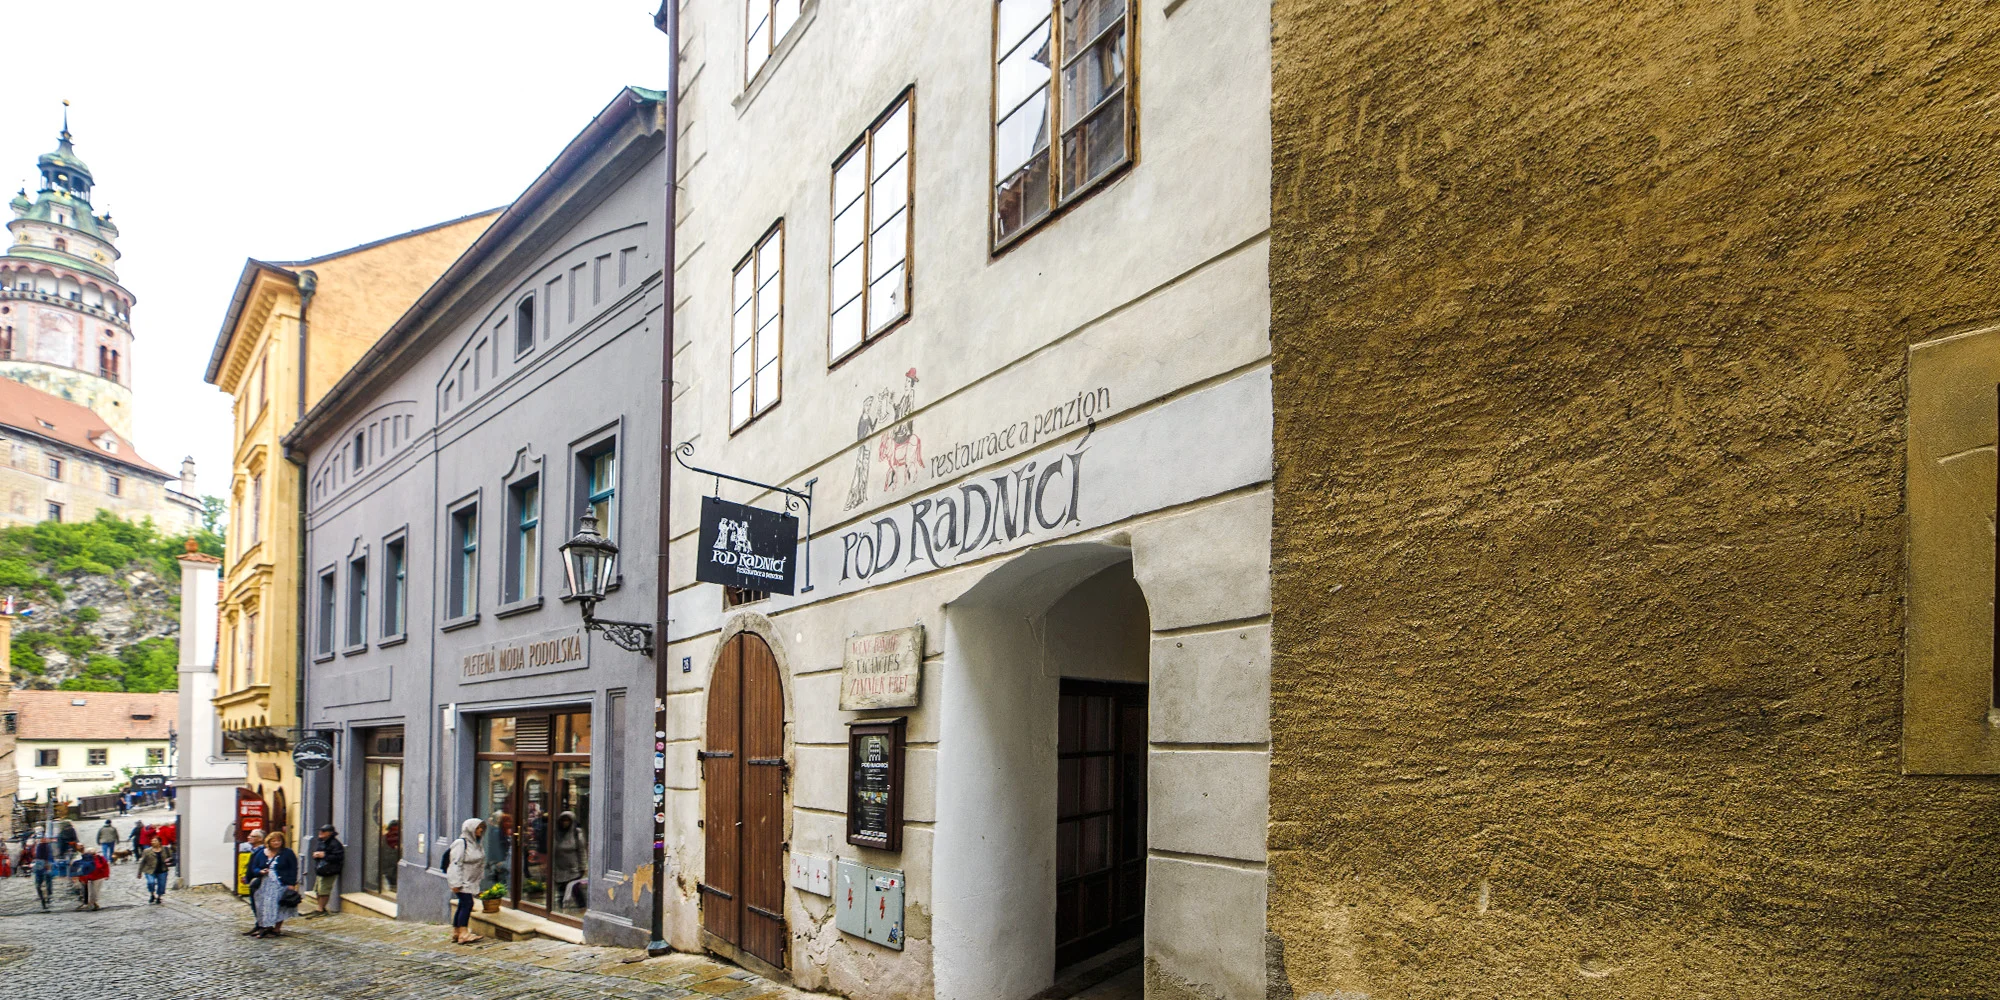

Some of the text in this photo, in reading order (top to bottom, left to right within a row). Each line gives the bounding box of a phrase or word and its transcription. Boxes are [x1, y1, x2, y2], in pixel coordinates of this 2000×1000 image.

[929, 386, 1111, 480] restaurace a penzion
[710, 549, 738, 566] POD
[838, 516, 901, 585] POD
[463, 628, 582, 677] PLETENÁ MÓDA PODOLSKÁ
